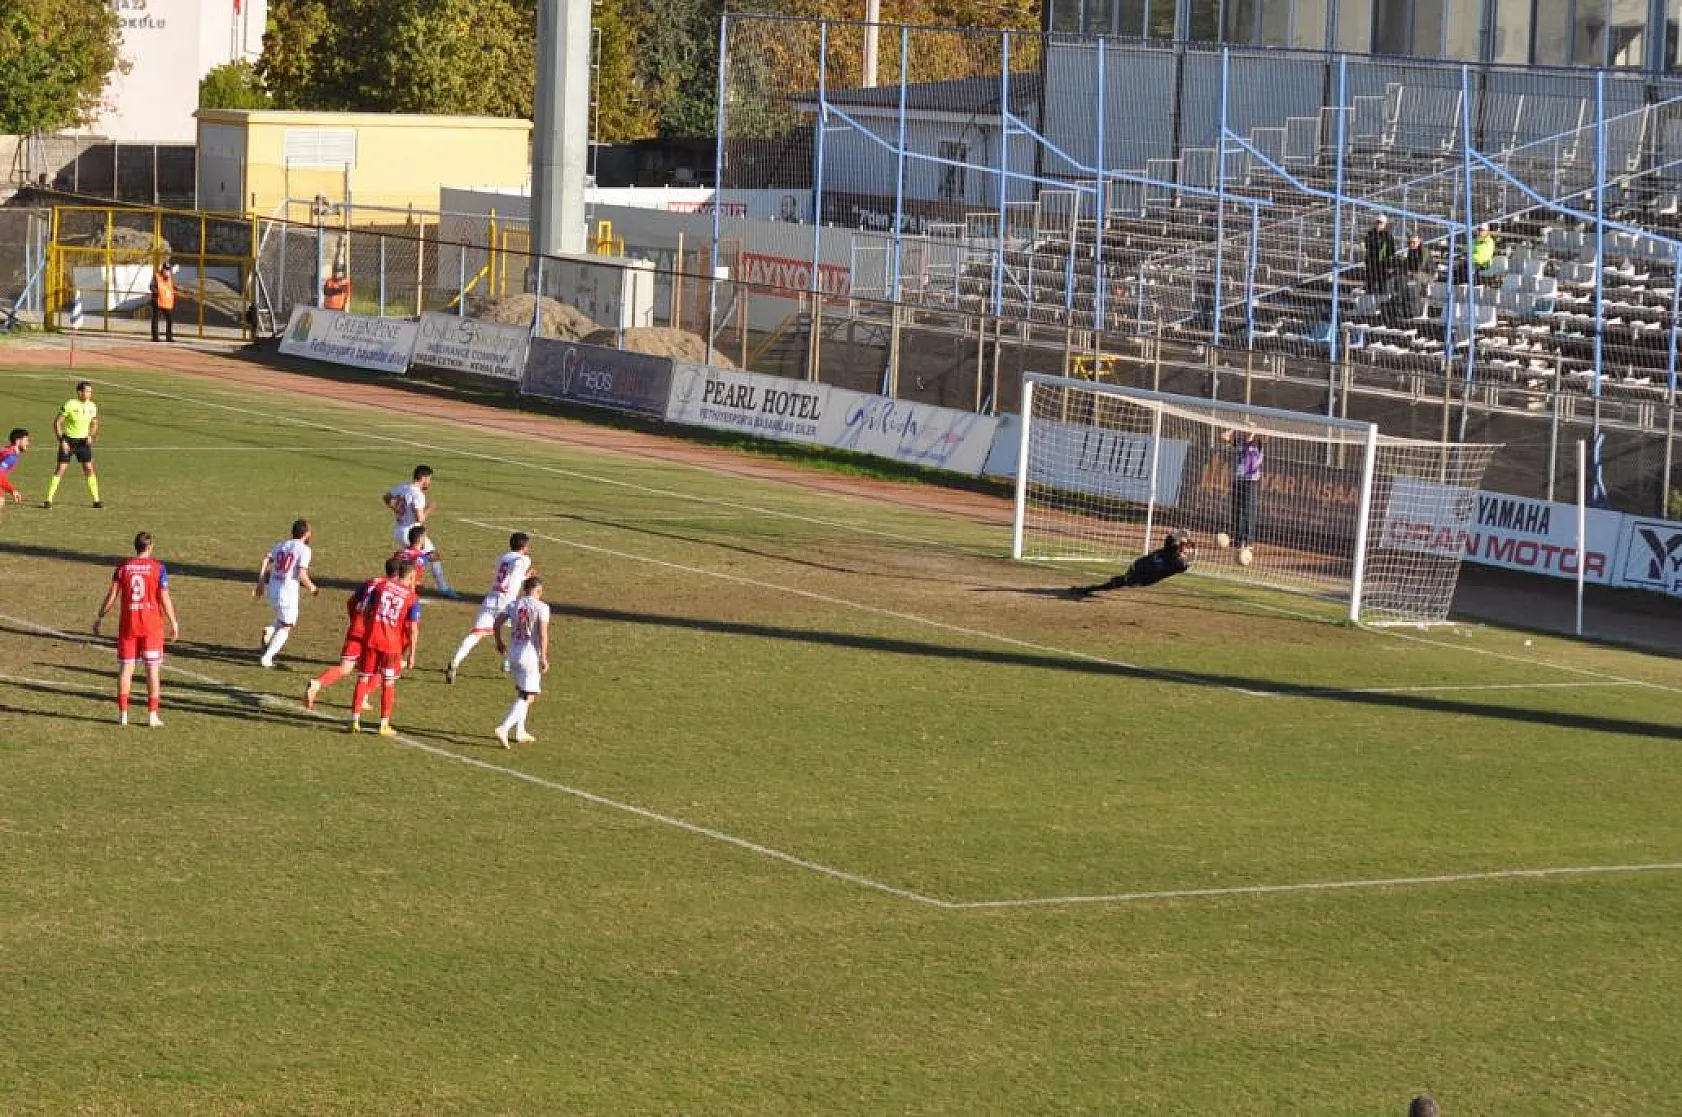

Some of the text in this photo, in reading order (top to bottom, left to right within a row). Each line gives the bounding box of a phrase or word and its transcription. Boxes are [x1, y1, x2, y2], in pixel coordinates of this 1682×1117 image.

[701, 380, 821, 420] PEARL HOTEL
[1477, 494, 1551, 535] YAMAHA
[1485, 535, 1606, 579] MOTOR
[131, 575, 146, 602] 9
